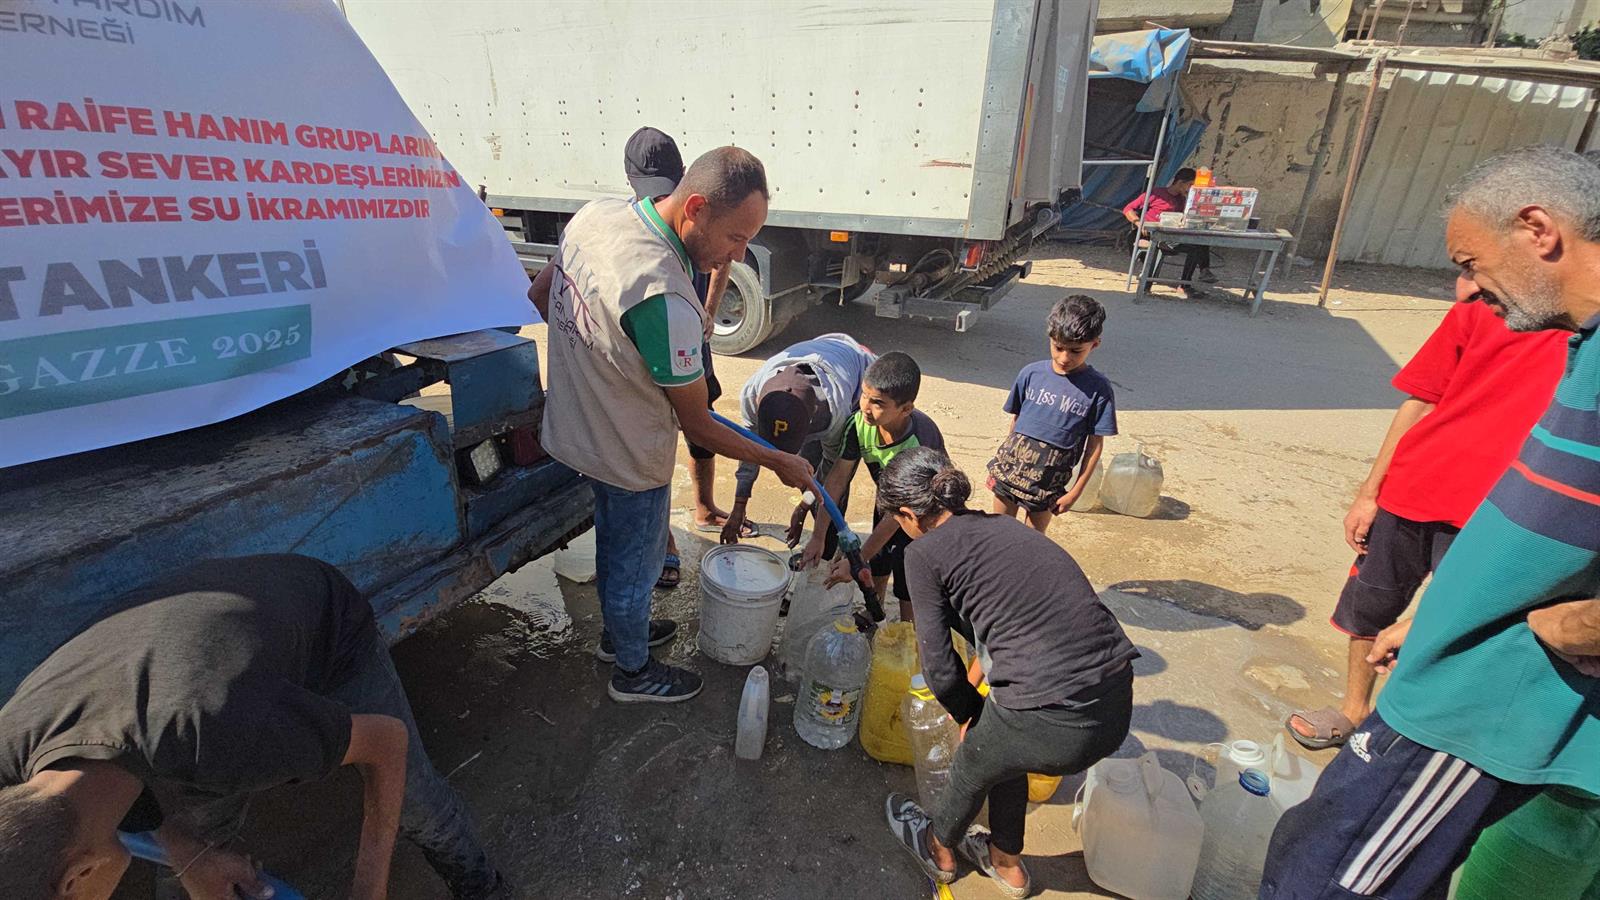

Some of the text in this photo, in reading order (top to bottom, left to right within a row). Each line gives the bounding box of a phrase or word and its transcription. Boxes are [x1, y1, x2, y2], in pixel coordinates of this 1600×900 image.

[15, 97, 157, 136] RAİFE
[163, 110, 289, 146] HANIM
[98, 151, 237, 182] SEVER
[246, 159, 462, 190] KARDEŞLERİMİZN
[189, 197, 241, 222] SU
[247, 192, 430, 221] İKRAMIMIZDIR
[0, 239, 327, 321] TANKERİ
[212, 323, 300, 360] 2025
[774, 419, 788, 437] P
